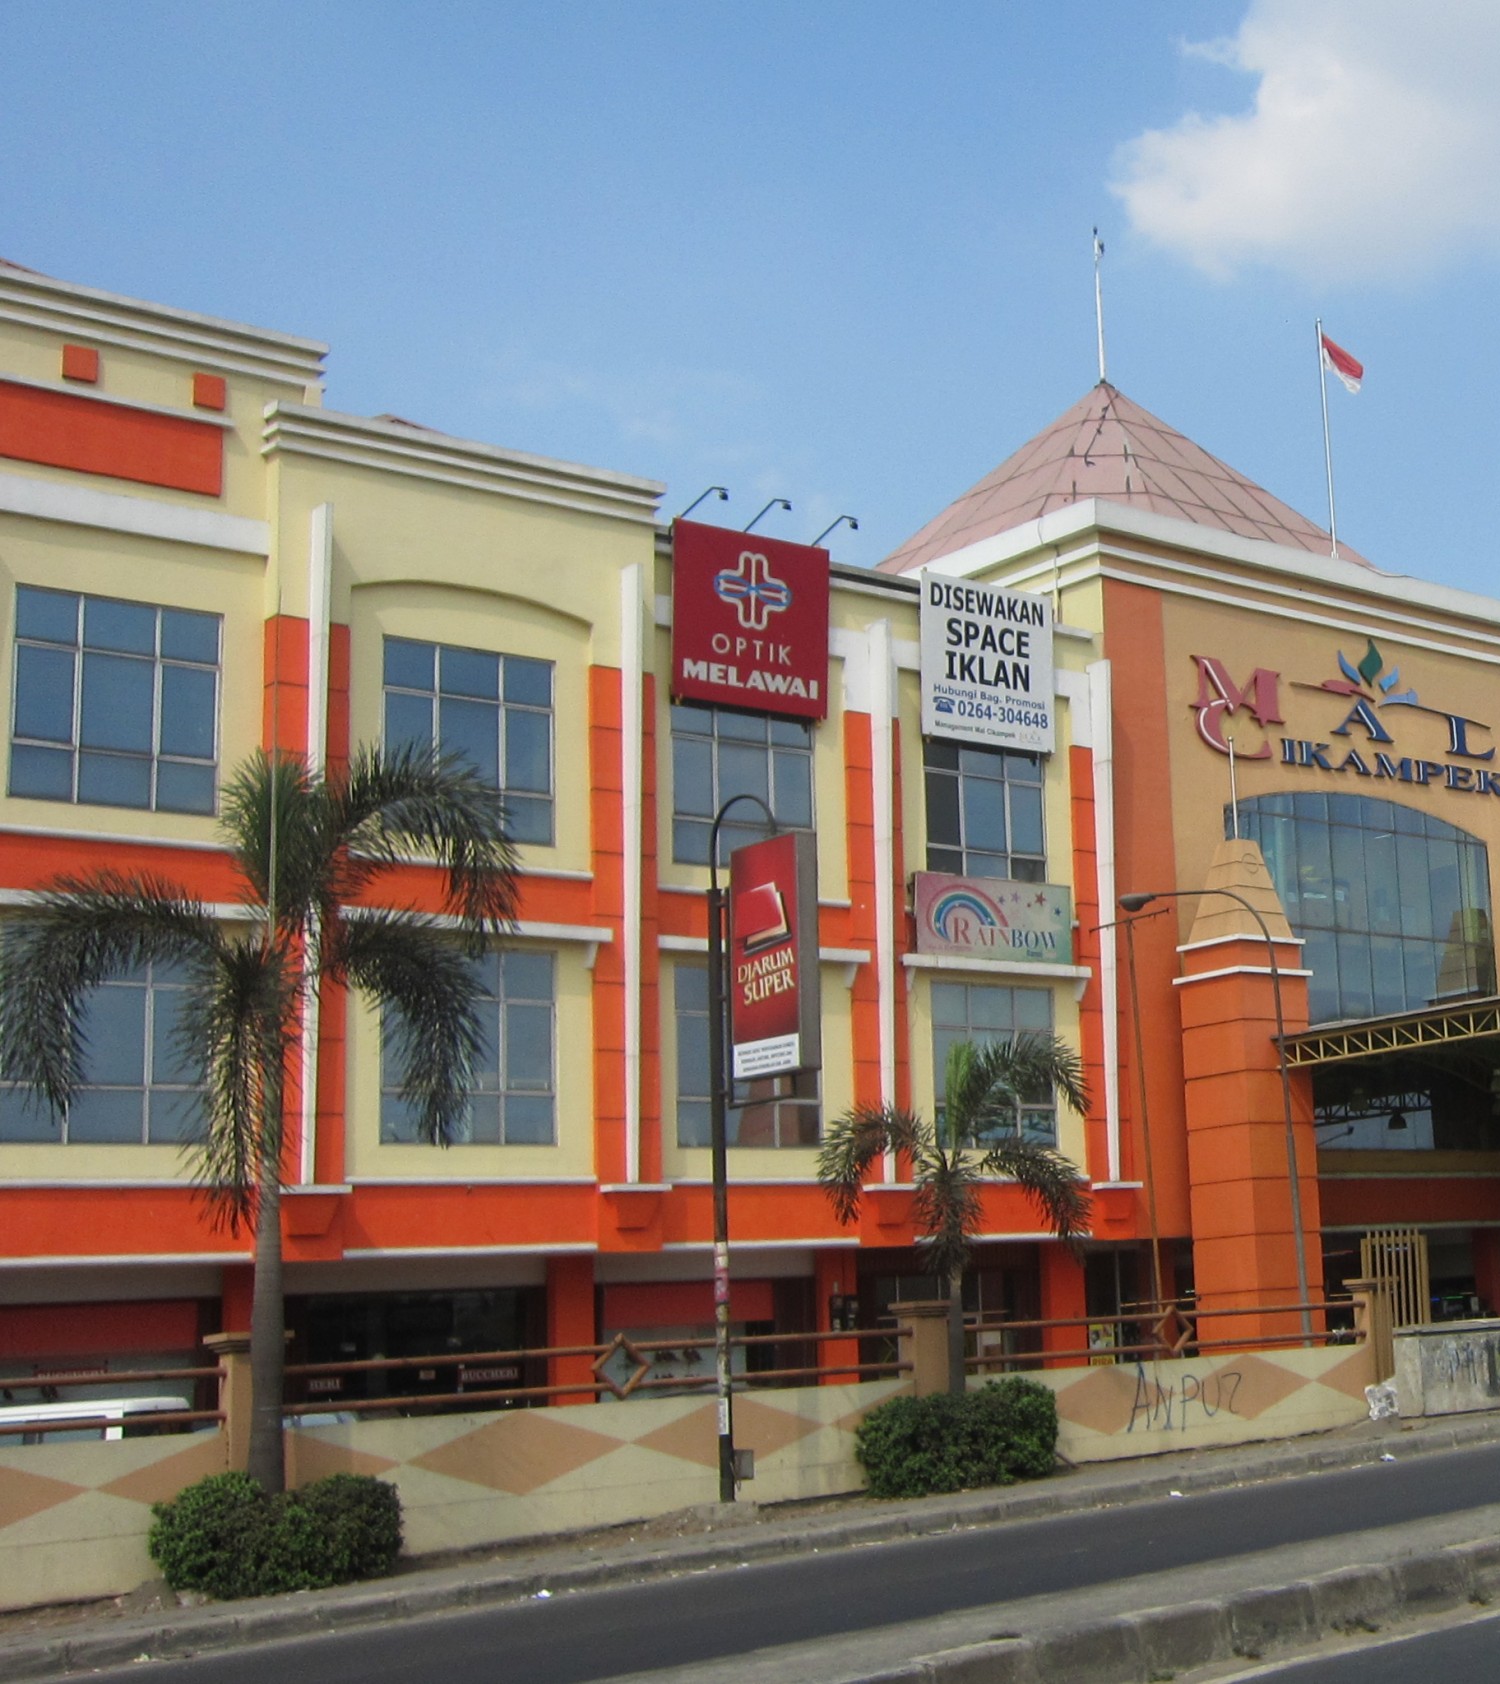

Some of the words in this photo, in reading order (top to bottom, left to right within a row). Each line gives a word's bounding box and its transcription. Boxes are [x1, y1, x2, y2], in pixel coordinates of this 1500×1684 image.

[930, 581, 1044, 627] DISEWAKAN
[712, 633, 791, 666] OPTIK
[946, 617, 1030, 659] SPACE
[683, 658, 819, 700] MELAWAI
[945, 650, 1030, 693] IKLAN
[933, 684, 977, 700] Hubungi
[980, 691, 1001, 704] Bag.
[1005, 695, 1045, 710] Promosi
[957, 700, 1049, 729] 0264-304648
[953, 917, 1057, 950] RAINBOW
[737, 947, 795, 984] DJARUM
[743, 968, 795, 1006] SUPER
